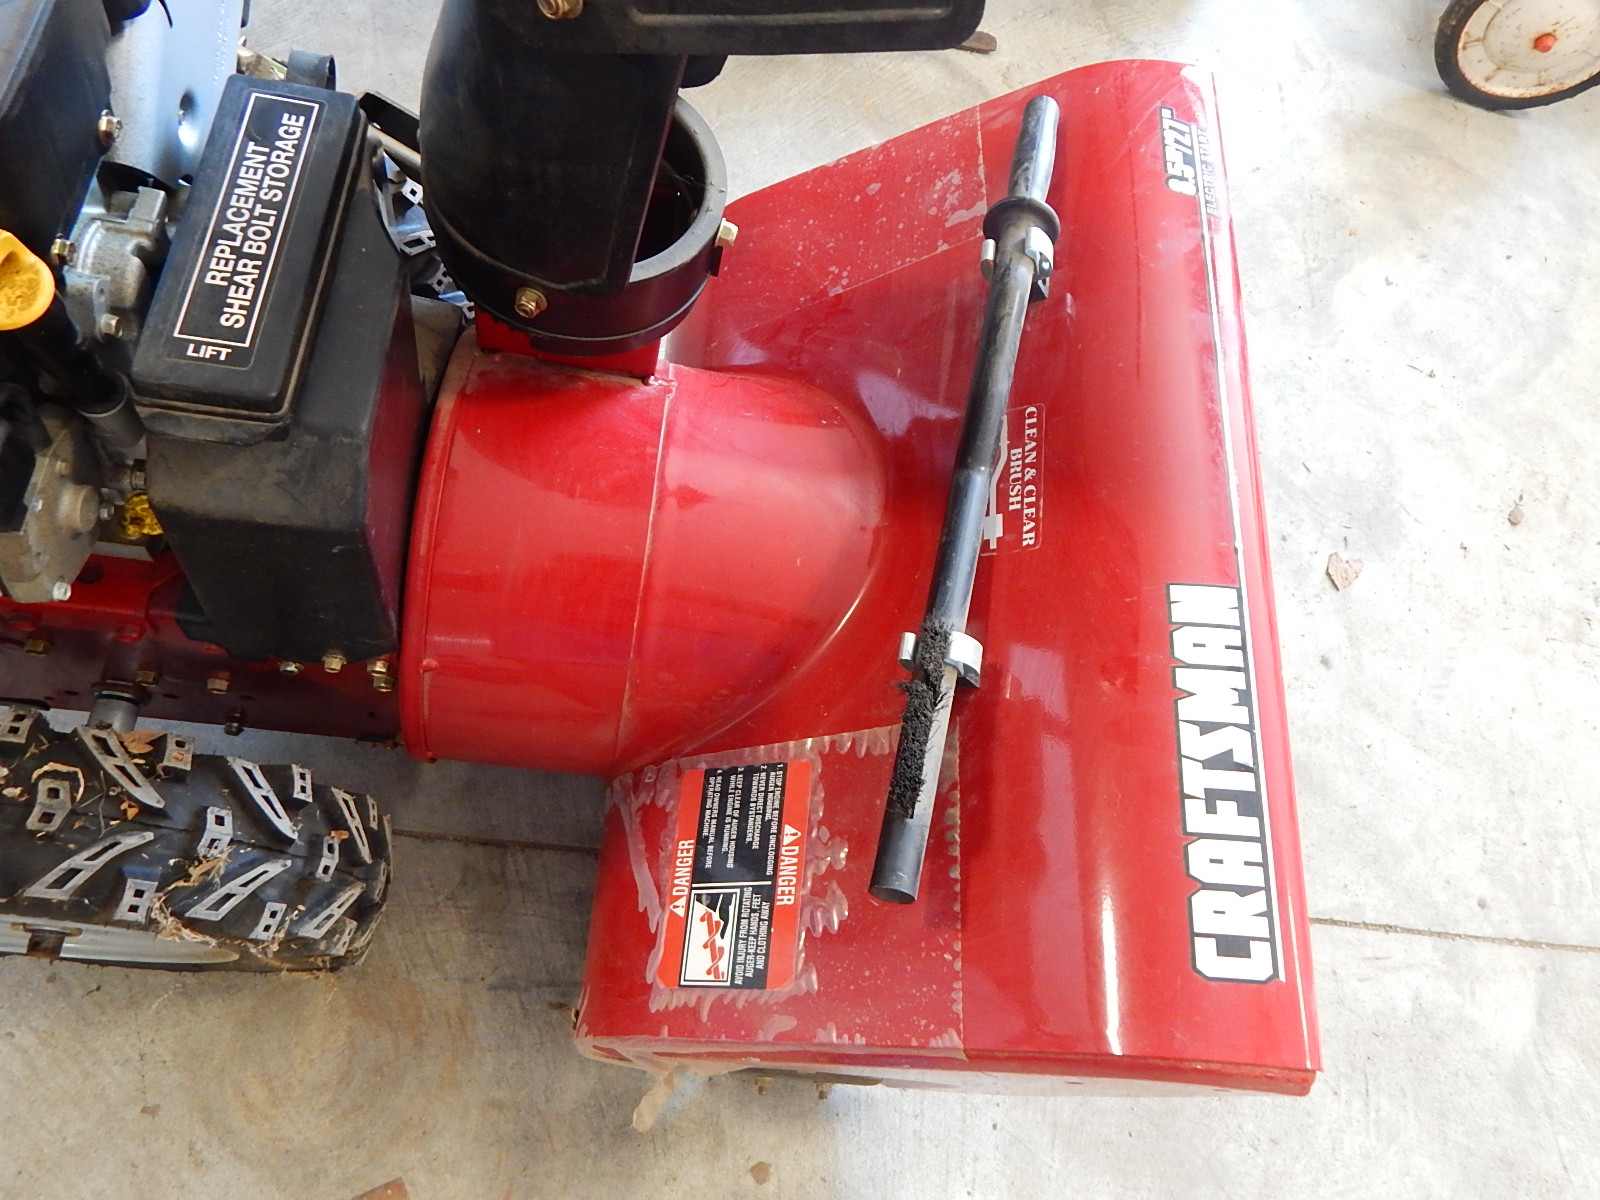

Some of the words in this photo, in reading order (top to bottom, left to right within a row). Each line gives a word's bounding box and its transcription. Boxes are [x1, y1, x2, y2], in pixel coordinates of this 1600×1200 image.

[259, 112, 306, 202] STORAGE
[1197, 128, 1210, 161] START
[1201, 162, 1216, 215] ELECTRIC
[204, 141, 270, 286] REPLACEMENT
[242, 204, 277, 256] BOLT
[220, 258, 263, 329] SHEAR
[186, 343, 232, 361] LIFT
[1024, 406, 1038, 463] CLEAN
[1009, 447, 1022, 511] BRUSH
[1024, 468, 1037, 482] &
[1022, 484, 1037, 547] CLEAR
[706, 777, 715, 808] OPERATING
[714, 777, 723, 791] READ
[728, 775, 736, 793] WHILE
[750, 773, 759, 801] TOWARDS
[775, 771, 783, 786] STOP
[1167, 583, 1275, 979] CRAFTSMAN
[711, 793, 719, 817] OWNERS
[725, 795, 733, 815] ENGINE
[756, 793, 764, 813] DIRECT
[765, 793, 774, 821] HOUSING.
[773, 788, 781, 808] ENGINE
[702, 810, 711, 838] MACHINE.
[708, 819, 717, 843] MANUAL
[730, 819, 738, 839] AUGER
[746, 803, 756, 843] BYSTANDERS.
[752, 815, 762, 849] DISCHARGE
[770, 810, 778, 833] BEFORE
[721, 824, 729, 854] RUNNING.
[673, 840, 694, 895] DANGER
[705, 845, 713, 868] BEFORE
[727, 841, 735, 868] HOUSING
[766, 835, 776, 875] UNCLOGGING
[776, 846, 799, 905] DANGER
[742, 887, 752, 917] ROTATING
[761, 902, 770, 920] AWAY
[739, 919, 748, 938] FROM
[745, 936, 757, 977] AUGER-KEEP
[753, 894, 761, 908] FEET
[757, 921, 768, 952] CLOTHING
[737, 940, 746, 962] INJURY
[756, 953, 764, 969] AND
[734, 963, 744, 984] AVOID
